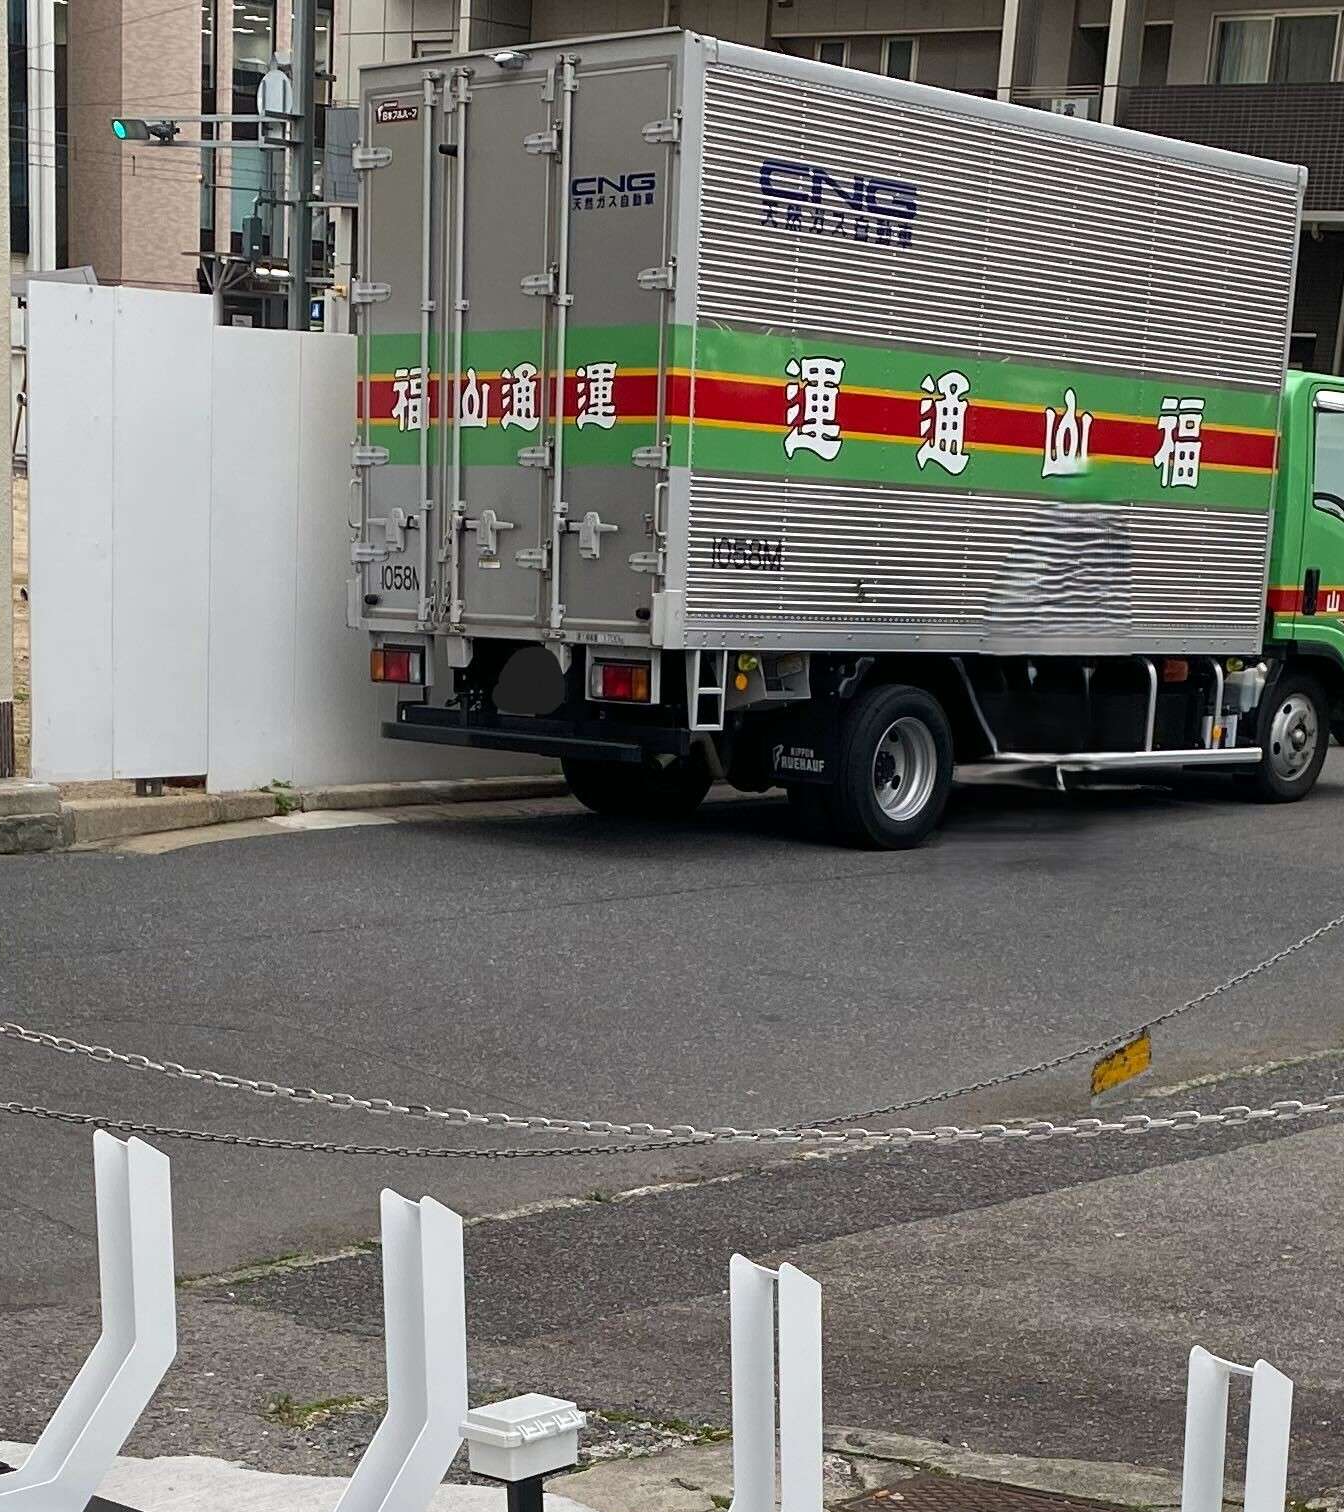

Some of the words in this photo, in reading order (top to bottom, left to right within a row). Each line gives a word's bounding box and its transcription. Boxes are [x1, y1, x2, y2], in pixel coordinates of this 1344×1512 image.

[572, 172, 656, 196] CNG
[759, 159, 918, 219] CNG
[1326, 589, 1341, 613] 山
